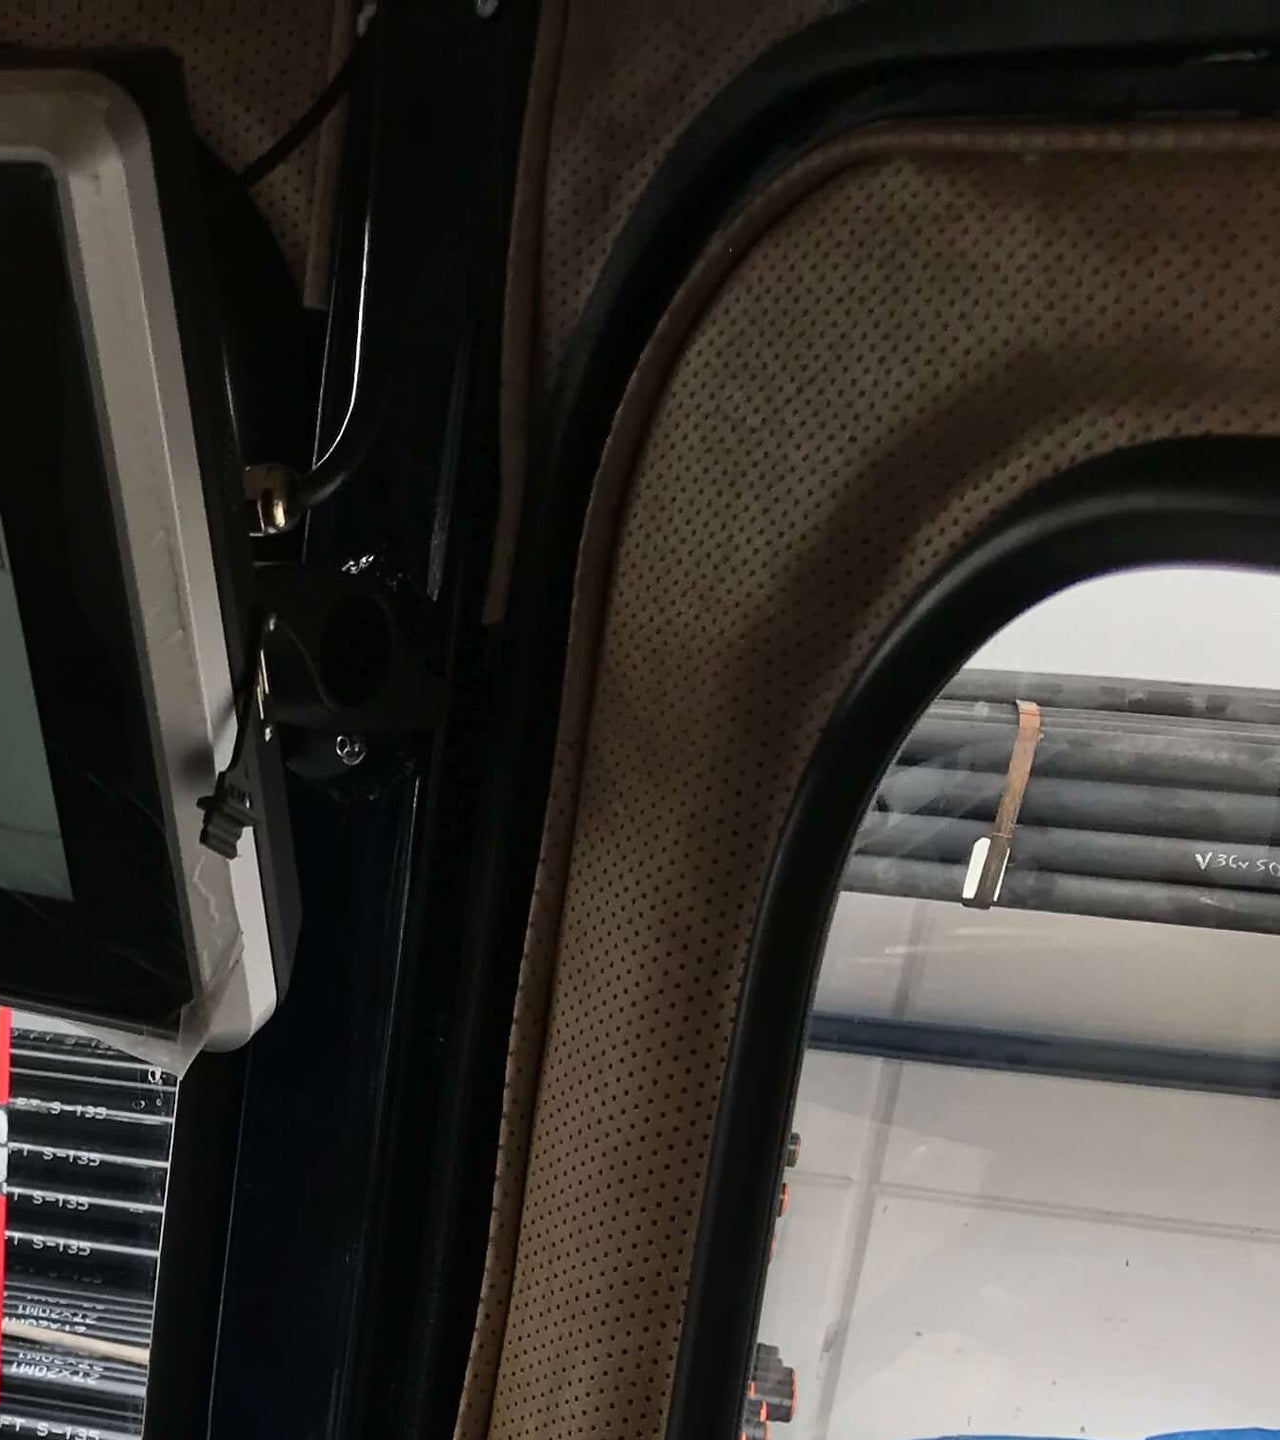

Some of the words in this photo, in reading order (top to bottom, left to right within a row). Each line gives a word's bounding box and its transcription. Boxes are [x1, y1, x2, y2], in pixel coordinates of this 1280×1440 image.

[32, 1191, 90, 1212] S-135
[31, 1236, 92, 1257] S-135
[0, 1415, 26, 1433] FT
